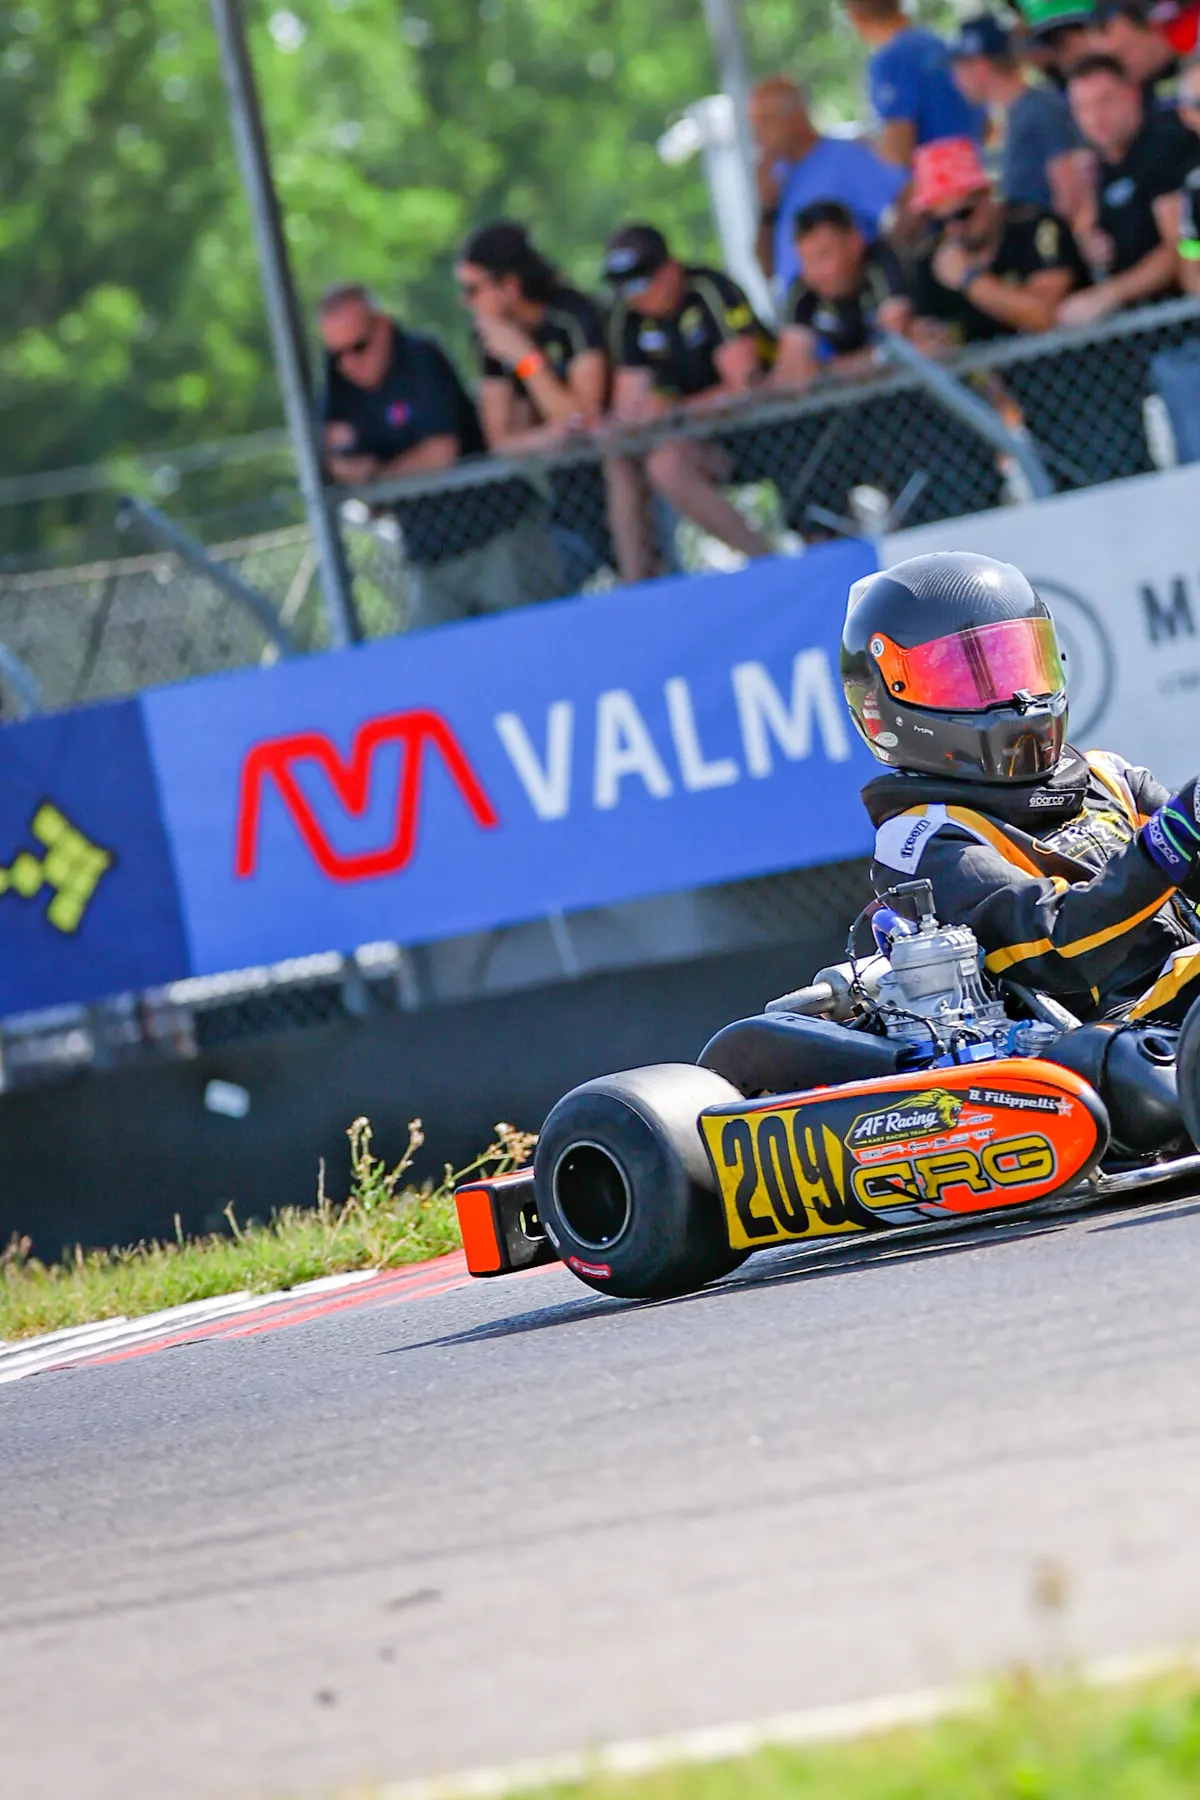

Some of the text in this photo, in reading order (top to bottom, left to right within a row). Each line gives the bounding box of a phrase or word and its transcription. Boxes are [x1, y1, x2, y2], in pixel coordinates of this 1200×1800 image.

[494, 646, 852, 822] VALM
[1029, 795, 1064, 807] sparco
[854, 1115, 885, 1139] AF
[885, 1110, 939, 1133] Racing
[984, 1091, 1056, 1109] Filippelli
[722, 1108, 848, 1239] 209
[852, 1133, 1055, 1210] CRG
